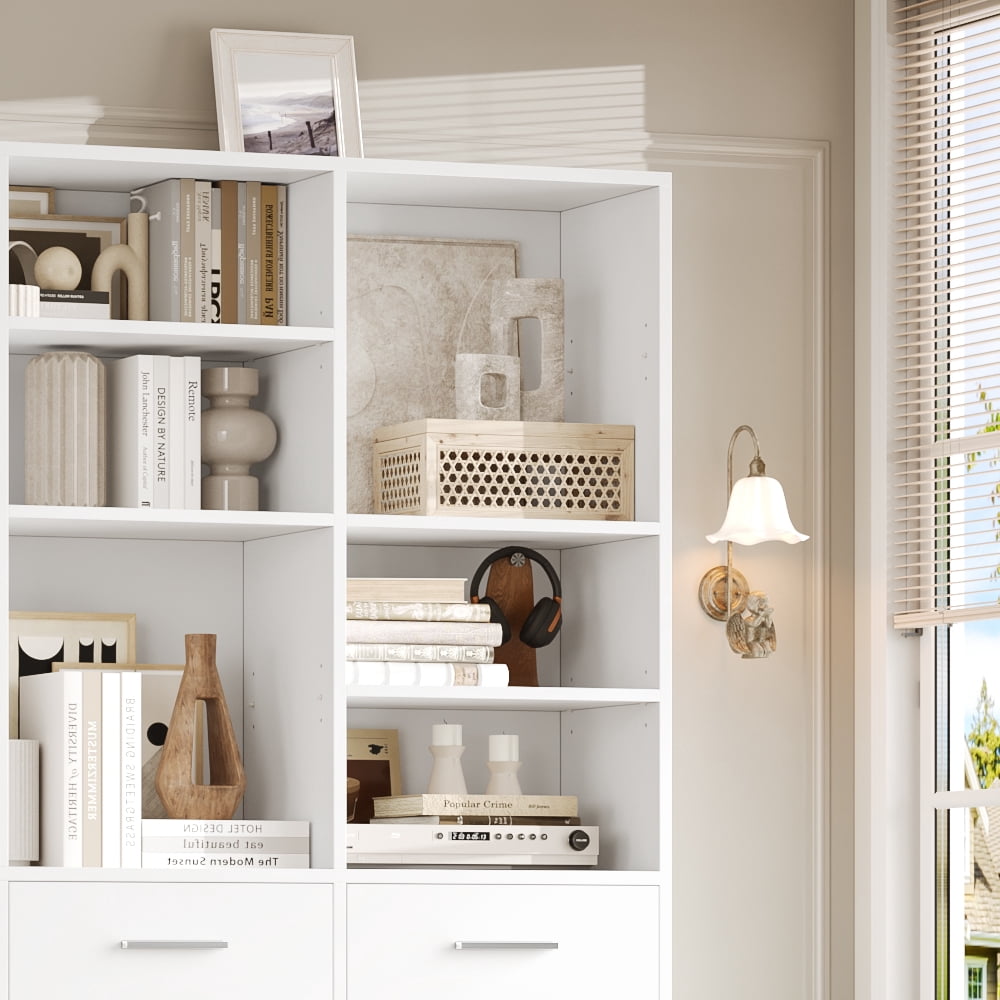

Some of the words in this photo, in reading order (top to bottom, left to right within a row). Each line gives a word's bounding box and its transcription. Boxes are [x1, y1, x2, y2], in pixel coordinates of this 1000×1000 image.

[141, 371, 150, 391] John
[142, 393, 150, 436] Lanchester
[158, 387, 166, 424] DESIGN
[188, 381, 198, 422] Remote
[158, 428, 166, 440] BY
[158, 442, 166, 482] NATURE
[444, 800, 480, 809] Popular
[483, 800, 513, 809] Crime
